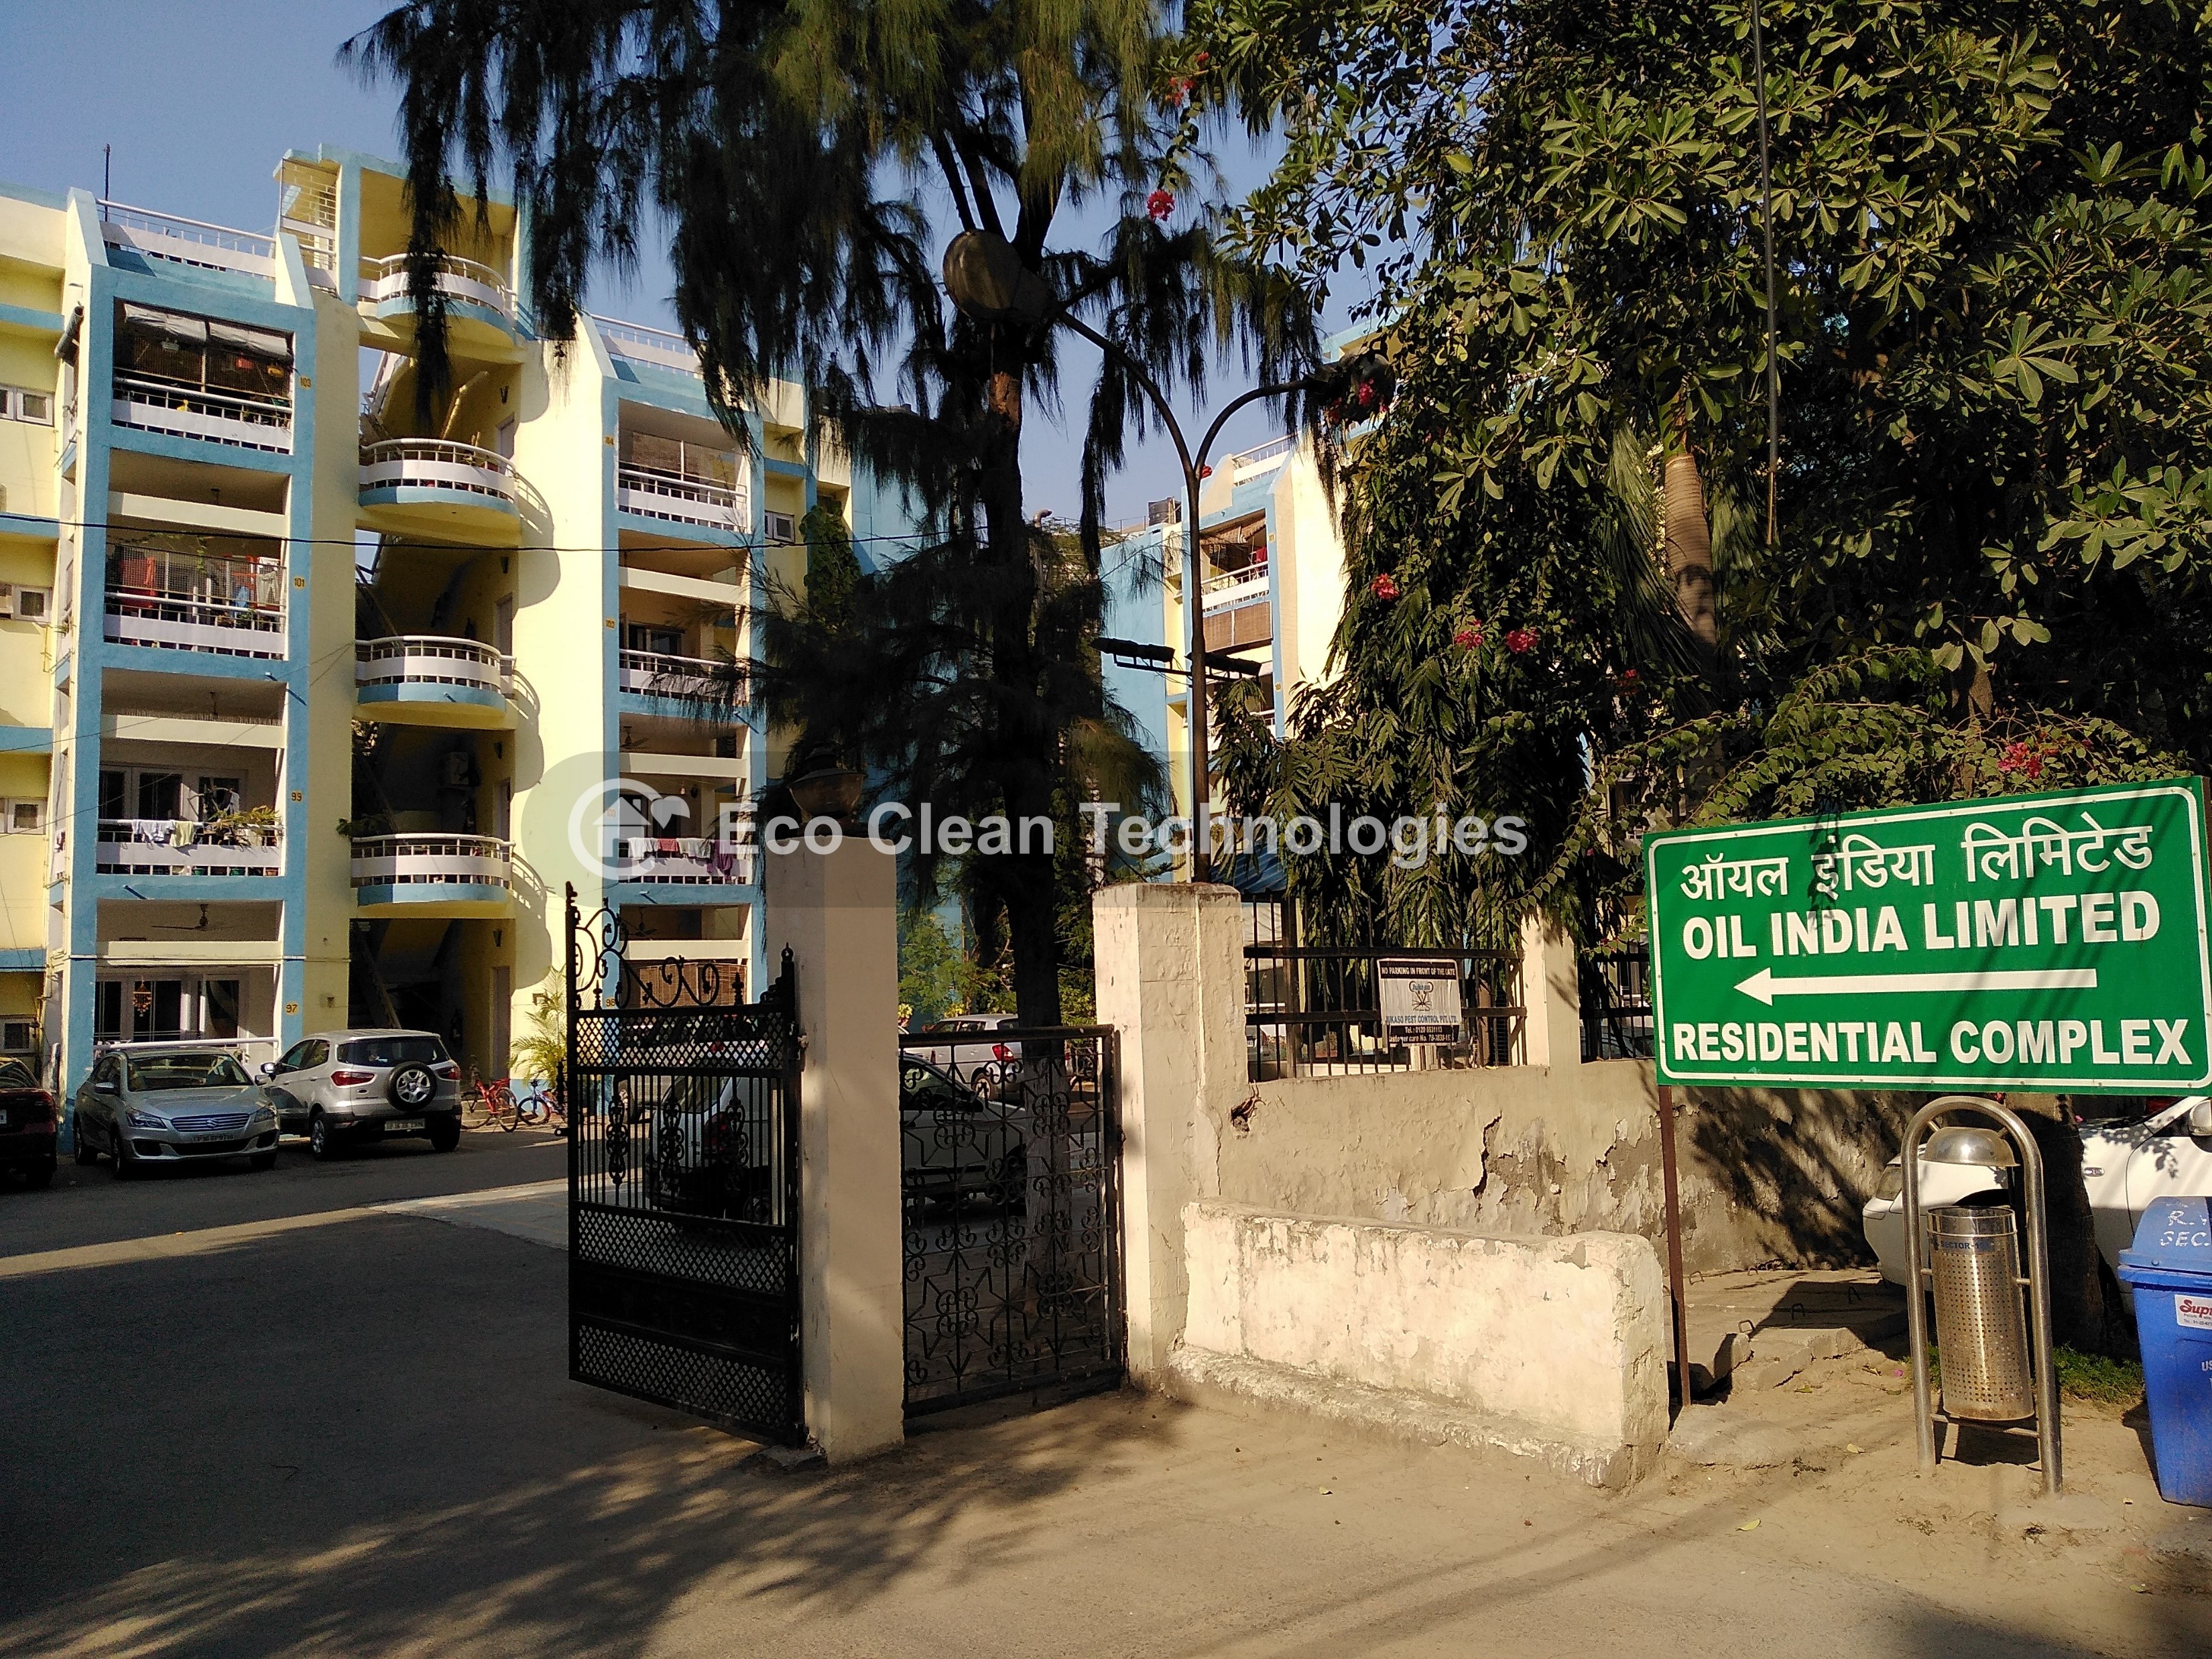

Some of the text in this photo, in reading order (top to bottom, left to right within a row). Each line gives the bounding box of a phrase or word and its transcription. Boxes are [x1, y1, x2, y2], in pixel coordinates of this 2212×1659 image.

[294, 577, 305, 587] 101
[291, 792, 302, 802] 99
[1680, 811, 2153, 901] ऑयल इंडिया लिमिटेड
[1682, 890, 2160, 960] OIL INDIA LIMITED
[1381, 967, 1388, 975] NO
[1389, 967, 1410, 975] PARKING
[1416, 967, 1430, 975] FRONT
[286, 1004, 298, 1013] 97
[1404, 1016, 1417, 1024] PEST
[1418, 1016, 1439, 1024] CONTROL
[1673, 1019, 2193, 1064] RESIDENTIAL COMPLEX
